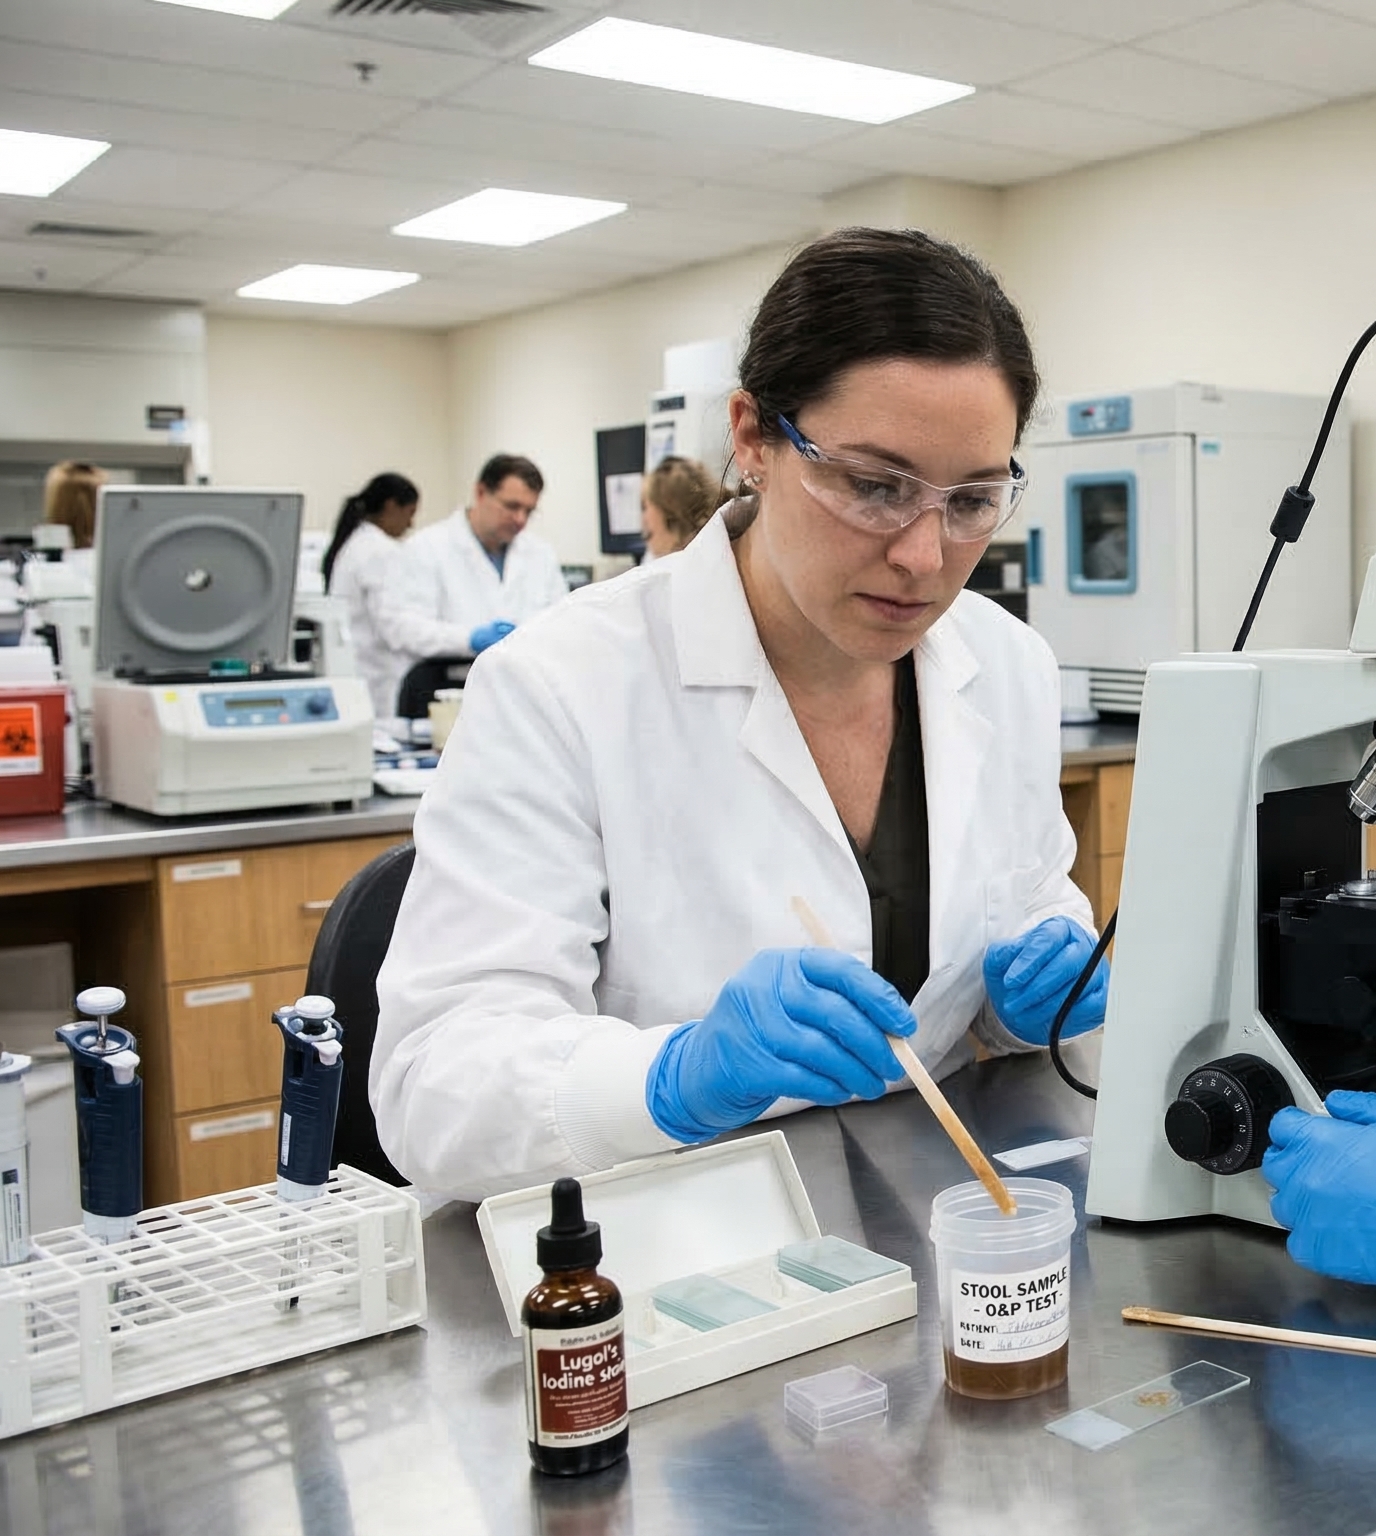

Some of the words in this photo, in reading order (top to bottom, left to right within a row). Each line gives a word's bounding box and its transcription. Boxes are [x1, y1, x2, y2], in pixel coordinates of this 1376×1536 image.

[960, 1282, 1012, 1298] STOOL
[1017, 1266, 1067, 1296] SAMPLE
[985, 1302, 1021, 1317] O&P
[1026, 1290, 1058, 1313] TEST
[560, 1344, 618, 1372] Lugol's
[543, 1372, 595, 1389] Iodine
